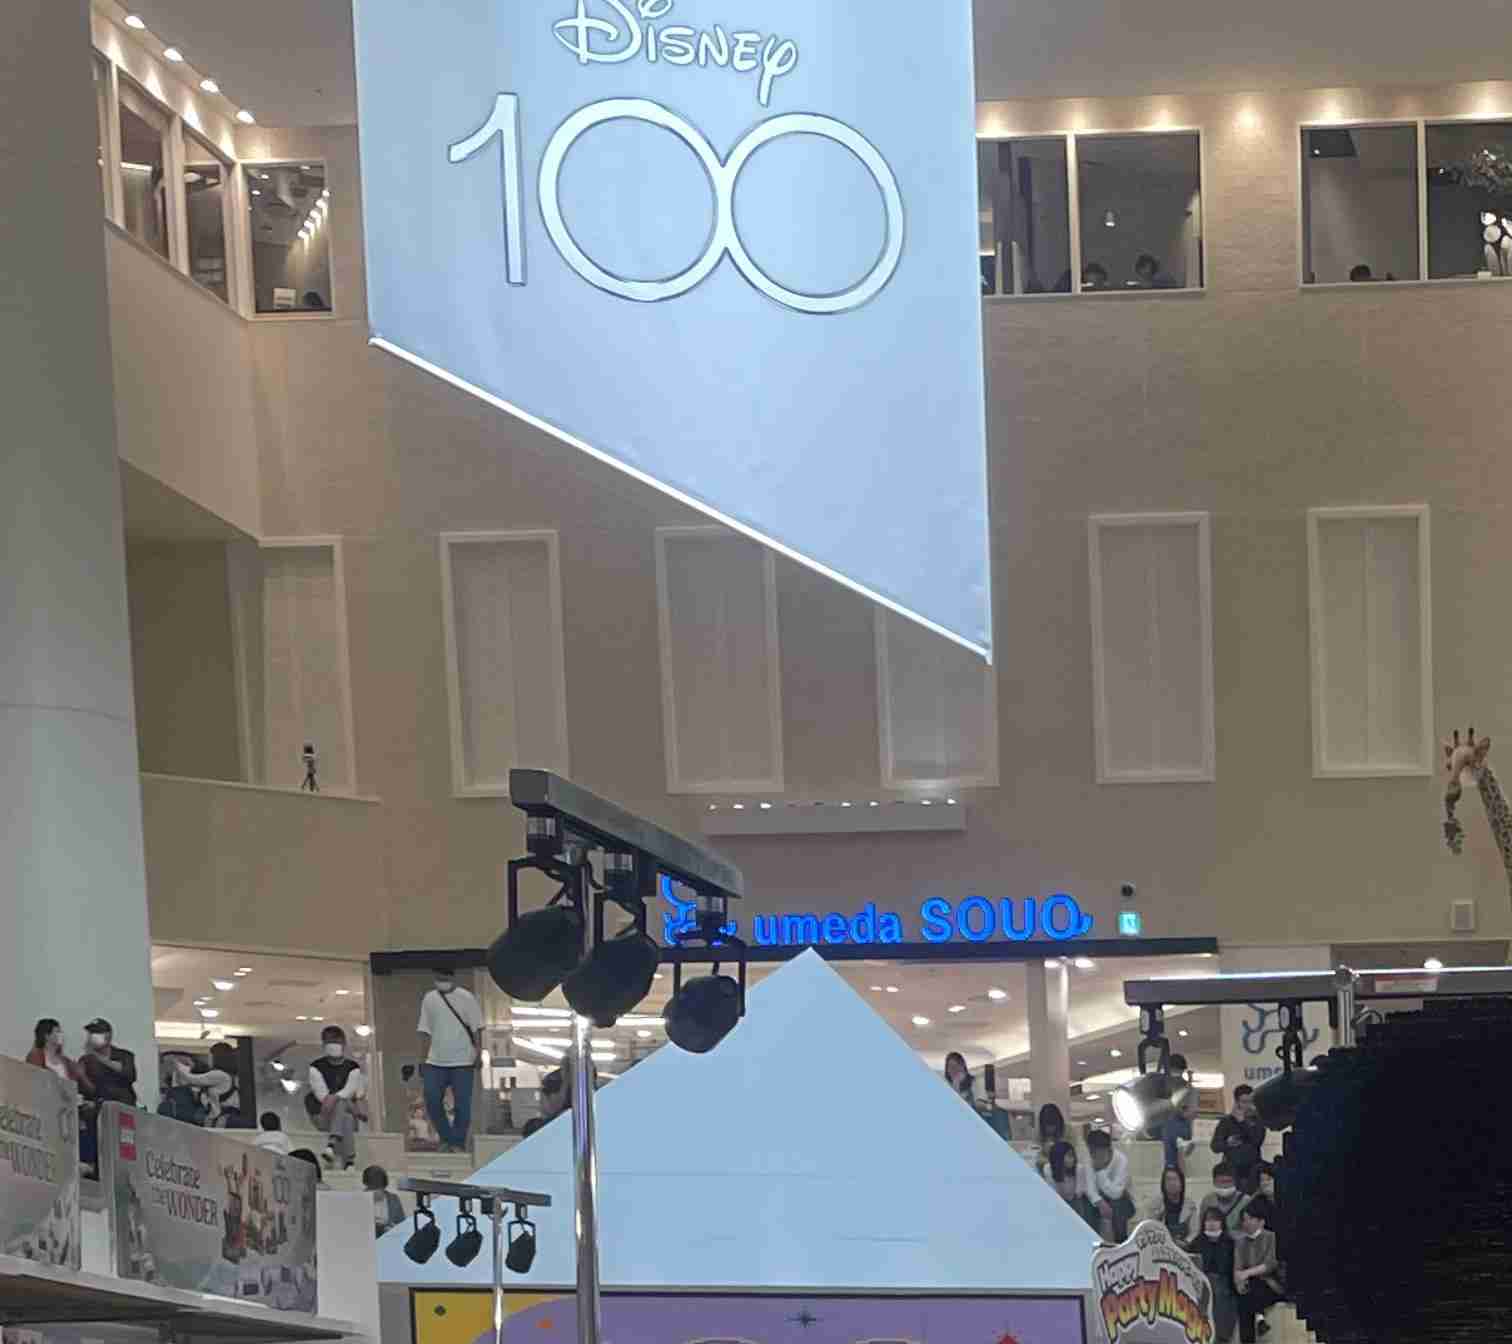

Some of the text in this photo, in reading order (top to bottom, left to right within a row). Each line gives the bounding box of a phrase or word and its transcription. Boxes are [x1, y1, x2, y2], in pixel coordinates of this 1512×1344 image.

[553, 0, 799, 106] Disney
[448, 92, 905, 314] 100
[754, 892, 1094, 945] umeda SOUQ
[167, 1190, 217, 1225] WONDER
